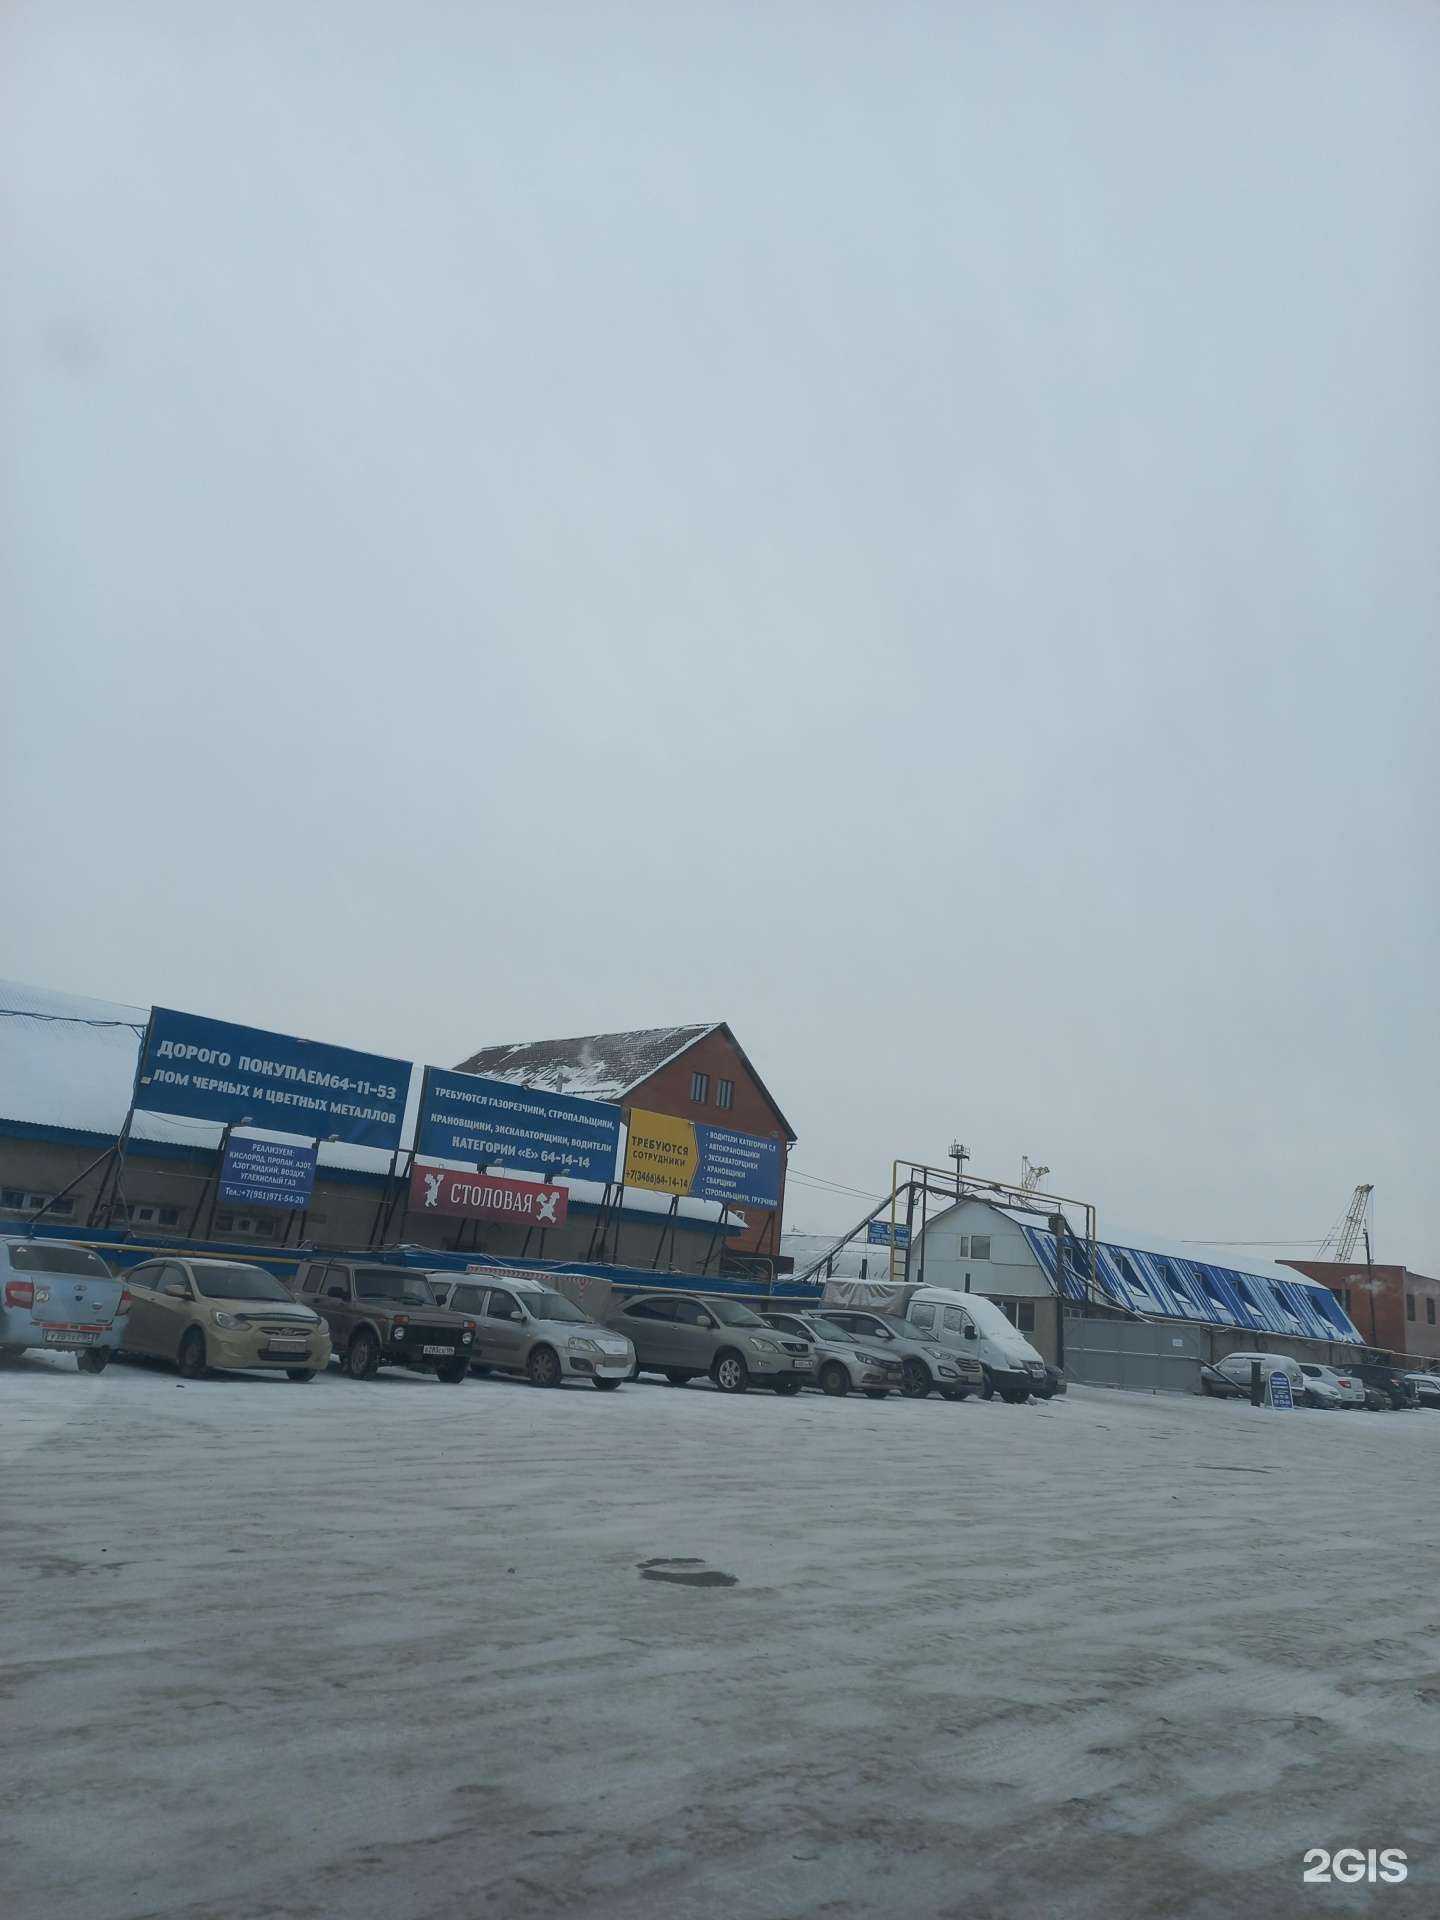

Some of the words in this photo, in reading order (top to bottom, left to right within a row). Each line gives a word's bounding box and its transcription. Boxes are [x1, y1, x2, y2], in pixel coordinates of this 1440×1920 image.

[157, 1040, 231, 1066] ДОРОГО
[153, 1069, 189, 1086] ЛОМ
[192, 1075, 250, 1097] ЧЕРНЫХ
[252, 1087, 263, 1099] И
[265, 1089, 328, 1112] ЦВЕТНЫХ
[329, 1102, 397, 1124] МЕТАЛЛОВ
[434, 1087, 487, 1105] ТРЕБУЮТСЯ
[430, 1113, 493, 1133] КРАНОВЩИКИ,
[571, 1138, 612, 1152] ВОДИТЕЛИ
[631, 1136, 689, 1156] ТРЕБУЮТСЯ
[451, 1136, 516, 1156] КАТЕГОРИИ
[540, 1150, 591, 1168] 64-14-14
[632, 1150, 686, 1167] СОТРУДНИКИ
[450, 1183, 533, 1213] СТОЛОВАЯ
